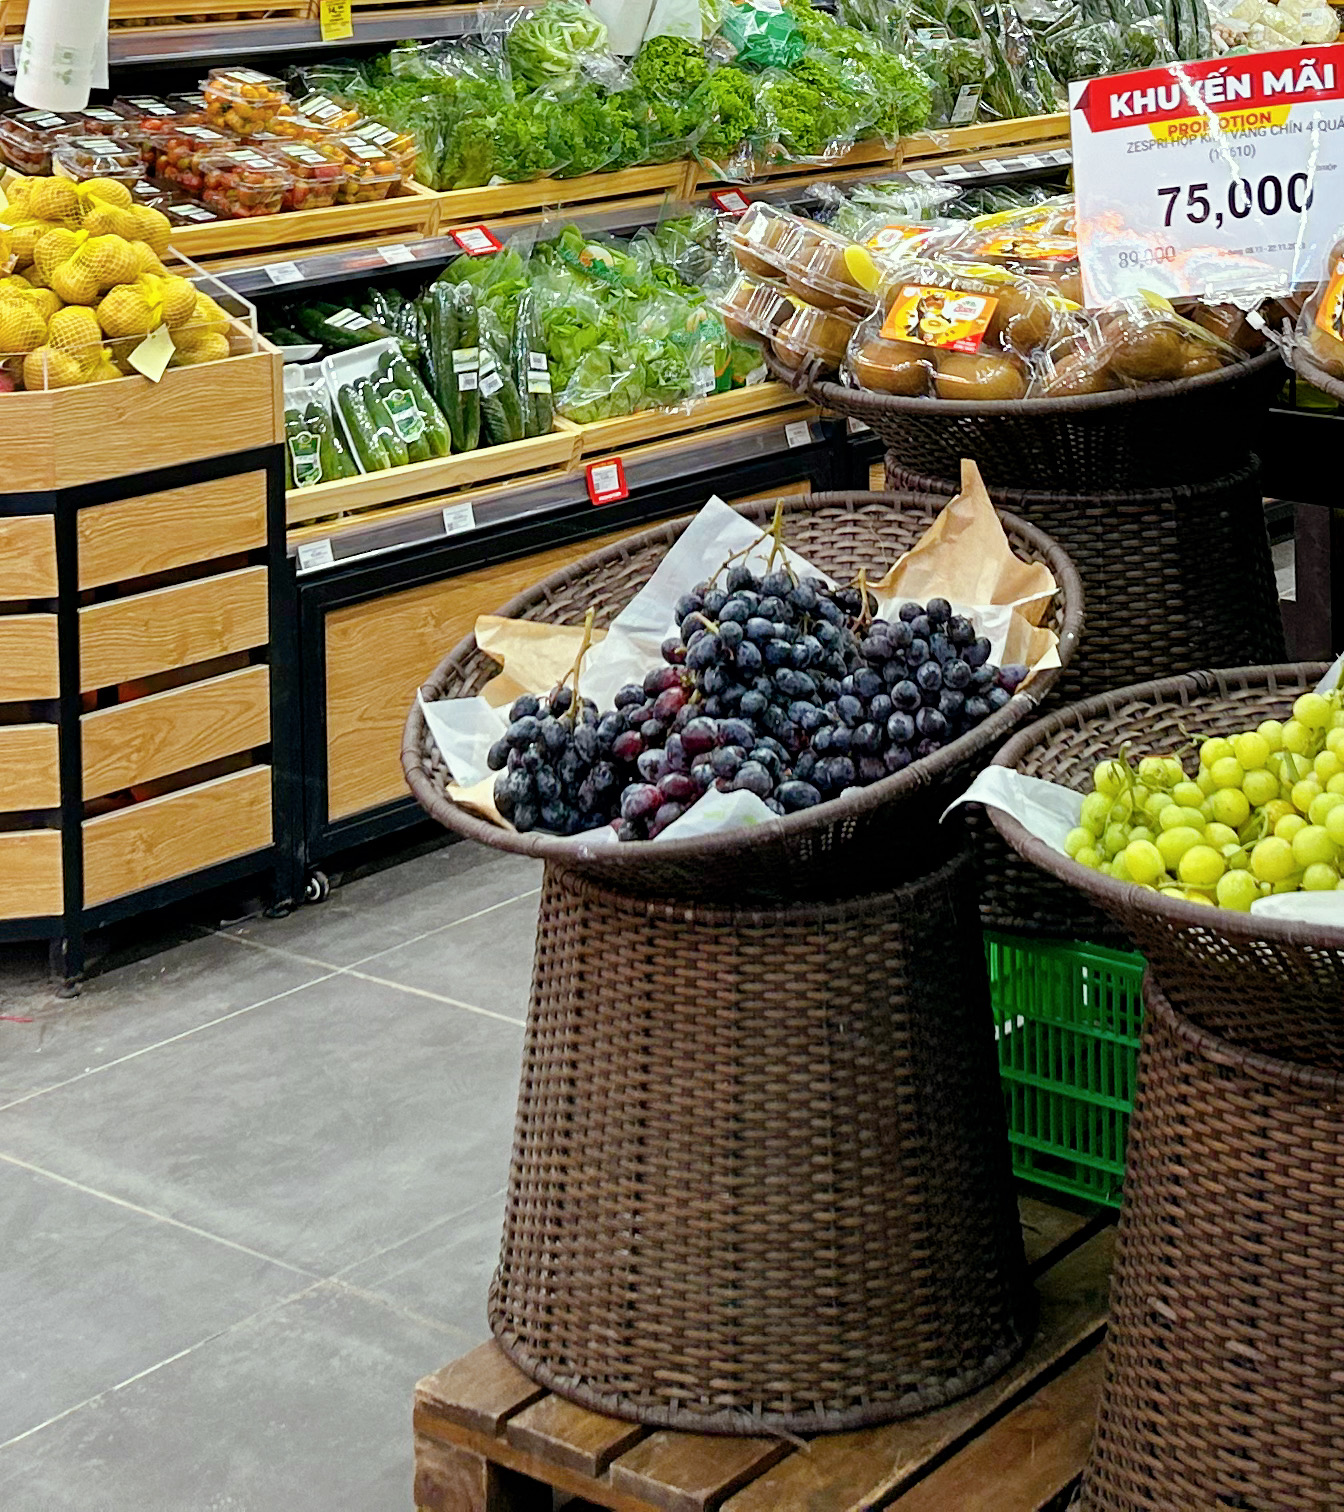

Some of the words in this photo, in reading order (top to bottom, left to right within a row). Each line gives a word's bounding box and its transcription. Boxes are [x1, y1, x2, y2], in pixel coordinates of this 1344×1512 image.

[1109, 69, 1253, 121] KHUYẾN
[1263, 58, 1336, 96] MÃI
[1232, 125, 1266, 140] VÀNG
[1270, 121, 1302, 136] CHÍN
[1306, 121, 1313, 131] 4
[1157, 172, 1314, 229] 75,000
[1118, 245, 1176, 268] 89,000
